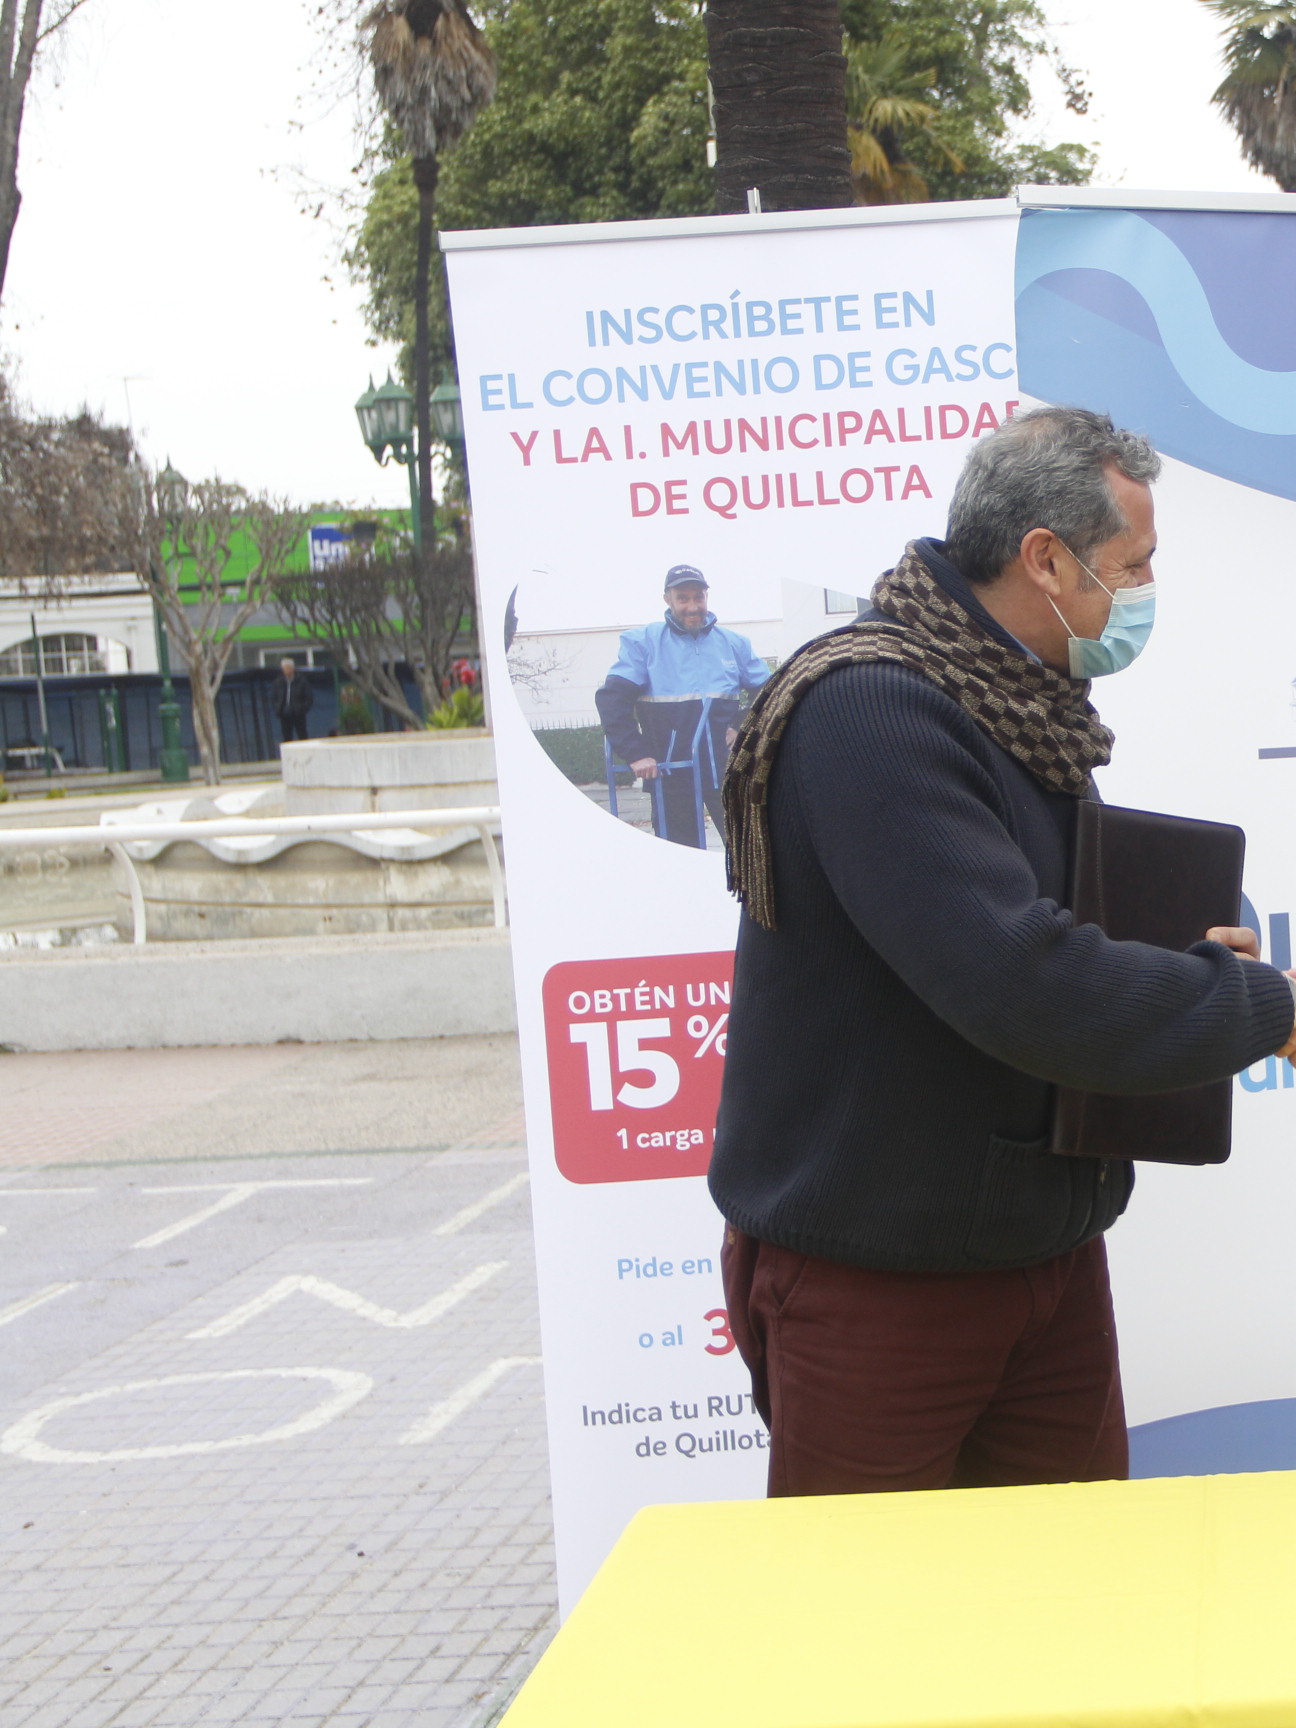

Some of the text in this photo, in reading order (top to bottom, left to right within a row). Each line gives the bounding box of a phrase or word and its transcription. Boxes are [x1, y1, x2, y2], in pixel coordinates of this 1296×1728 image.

[586, 289, 935, 347] INSCRÍBETE EN
[479, 342, 1015, 411] EL CONVENIO DE GASC
[509, 430, 539, 466] Y
[553, 427, 613, 464] LA
[623, 424, 647, 460] I.
[629, 464, 933, 519] DE QUILLOTA
[568, 979, 731, 1014] OBTÉN UN
[616, 1128, 628, 1149] 1
[636, 1129, 703, 1151] carga
[617, 1256, 713, 1280] Pide en
[638, 1333, 654, 1348] o
[661, 1324, 683, 1347] al
[582, 1402, 662, 1426] Indica
[670, 1400, 699, 1421] tu
[635, 1429, 771, 1458] de Quillot
